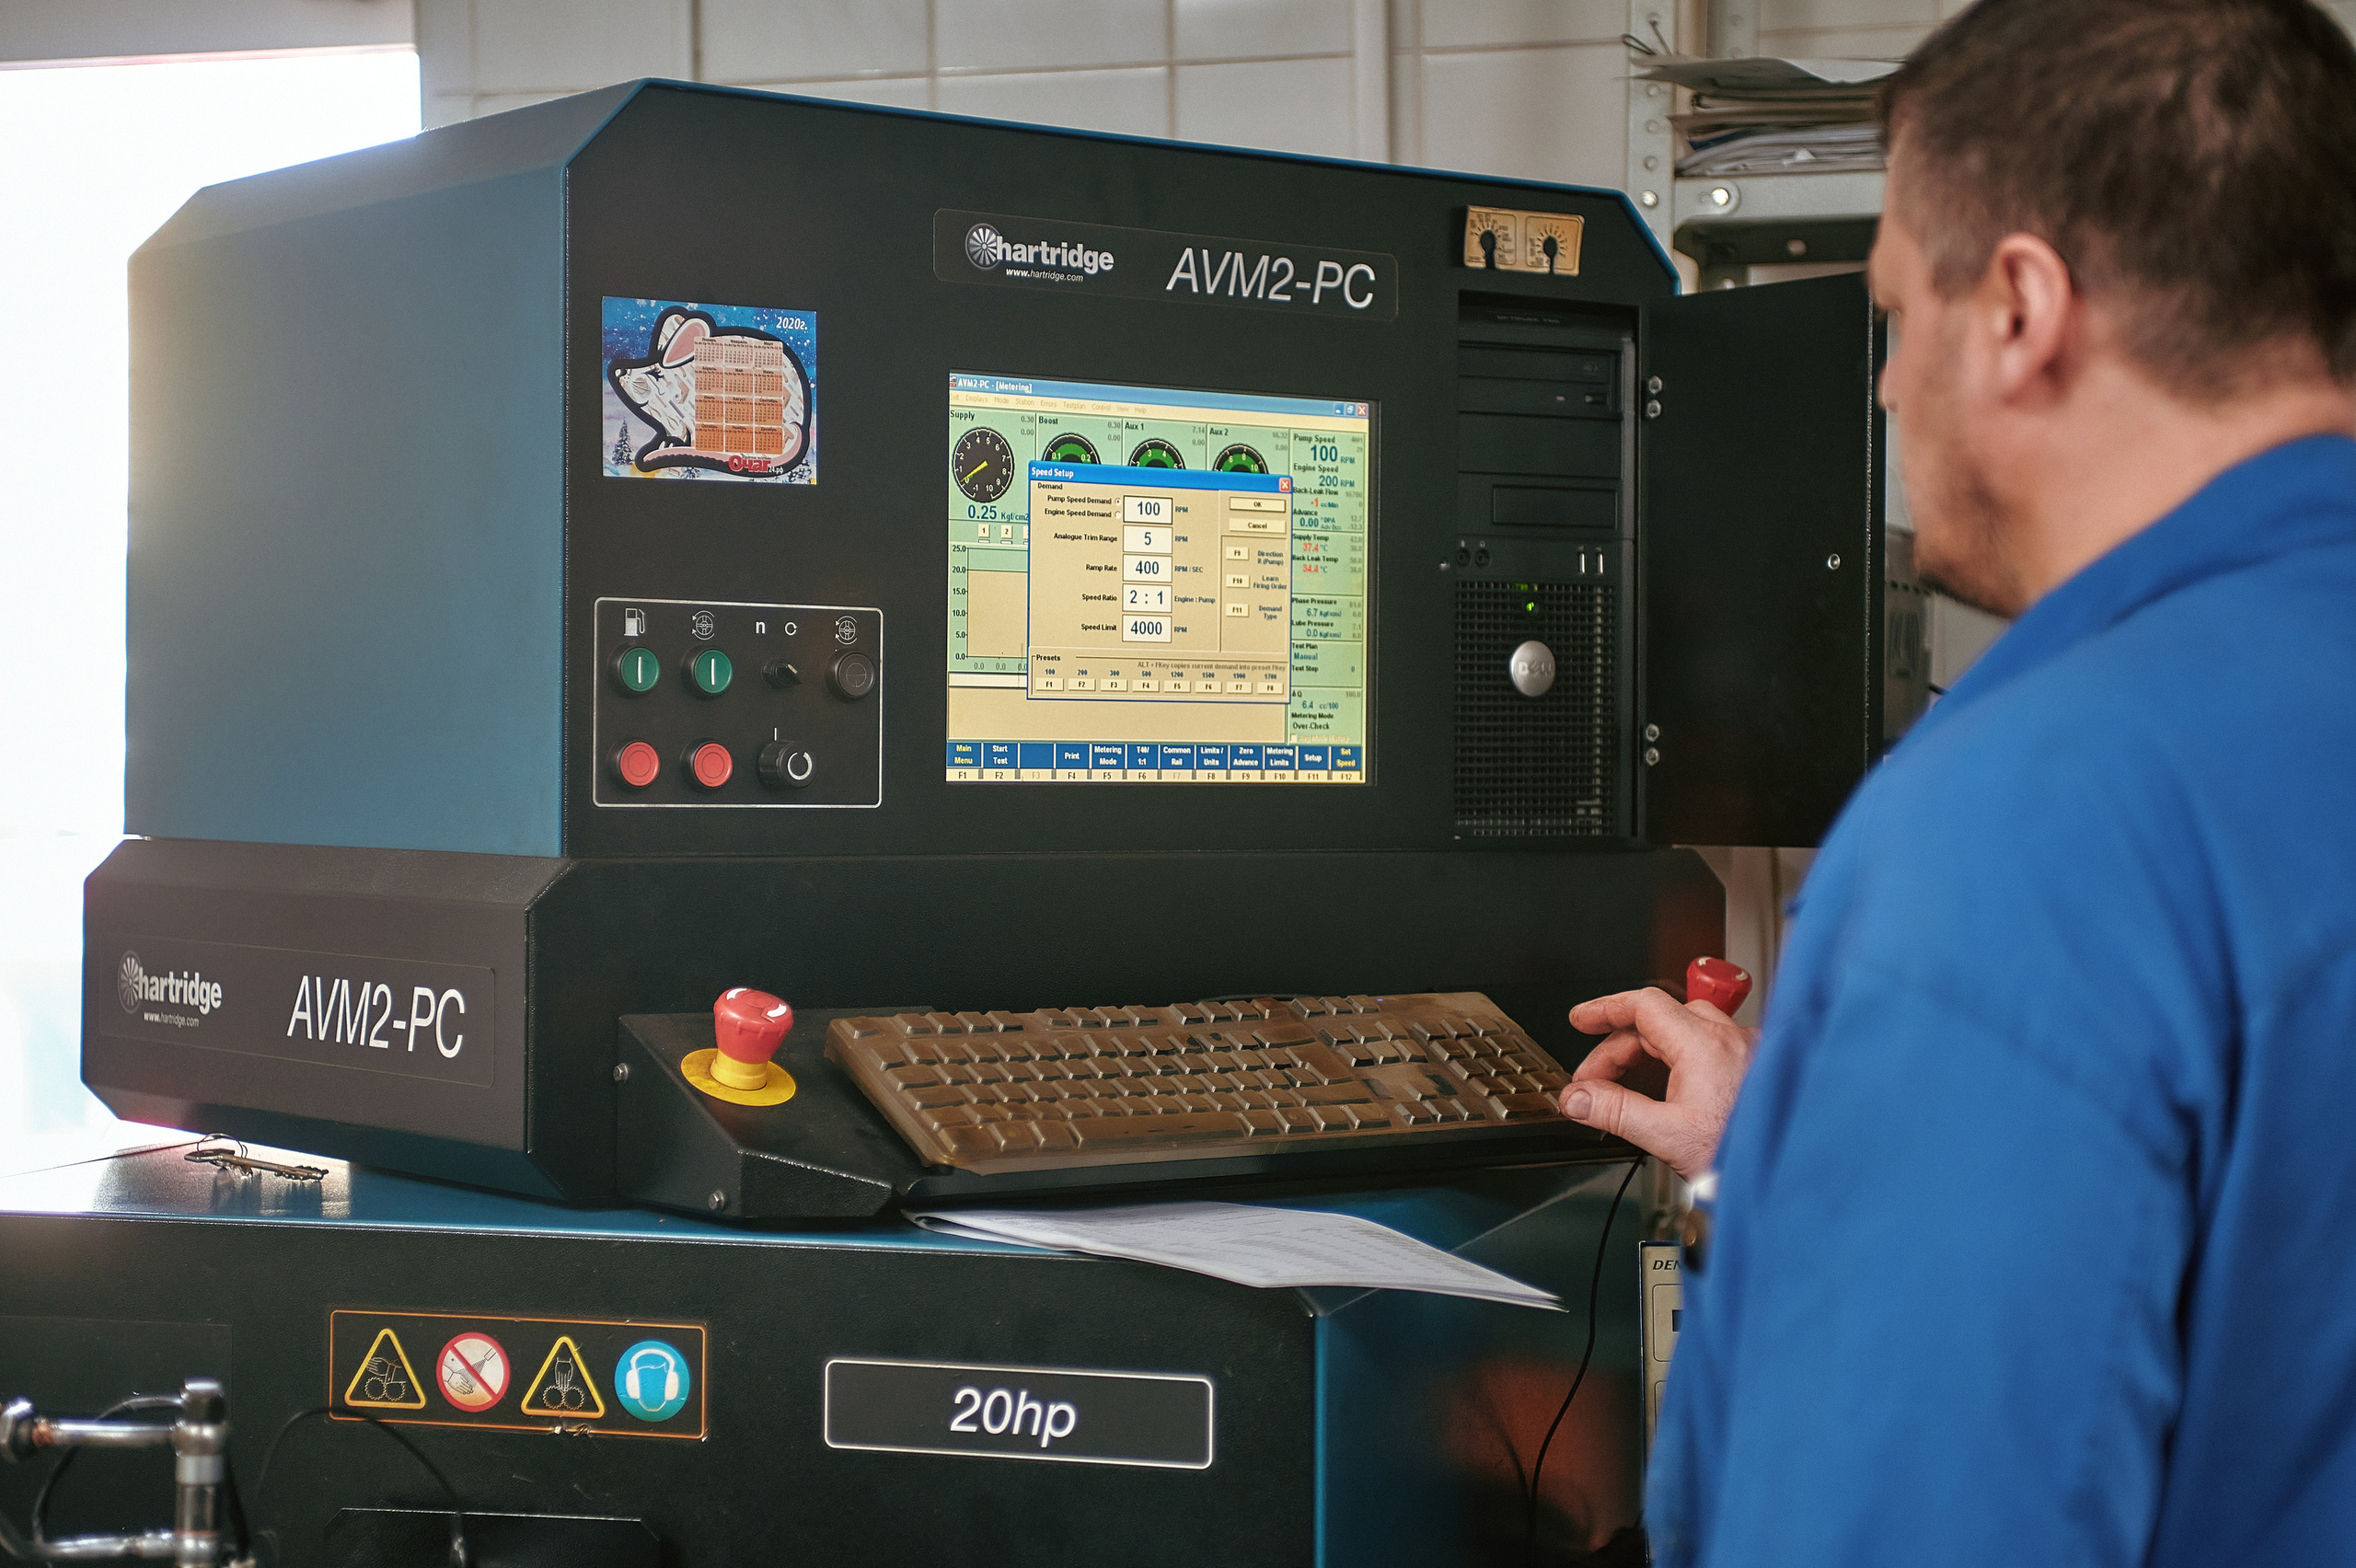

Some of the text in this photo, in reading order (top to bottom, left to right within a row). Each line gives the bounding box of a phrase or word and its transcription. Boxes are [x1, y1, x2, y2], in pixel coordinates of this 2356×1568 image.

[996, 236, 1376, 309] hartridge AVM2-PC
[1006, 267, 1084, 282] www.hartridge.com
[958, 377, 1032, 393] AVM2-PC [Metering]
[1041, 399, 1057, 408] Errors
[950, 410, 975, 421] Supply
[1294, 433, 1335, 444] Pump Speed
[1311, 444, 1338, 461] 100
[729, 455, 770, 472] Очаг
[1294, 463, 1338, 473] Engine Speed
[1032, 467, 1074, 478] Speed Setup
[1320, 475, 1338, 487] 200
[968, 505, 997, 519] 0.25
[1138, 502, 1161, 515] 100
[1300, 517, 1319, 526] 0.00
[1145, 532, 1151, 545] 5
[1303, 543, 1318, 551] 37.4
[1136, 560, 1159, 574] 400
[1303, 564, 1318, 572] 34.4
[1130, 590, 1138, 604] 2
[1307, 608, 1318, 617] 6.7
[1131, 621, 1162, 635] 4000
[1302, 700, 1313, 709] 6.4
[1094, 746, 1122, 755] Metering
[138, 967, 465, 1058] hartridge AVM2-PC
[144, 1011, 200, 1028] www.hartridge.com
[950, 1388, 1076, 1447] 20hp
